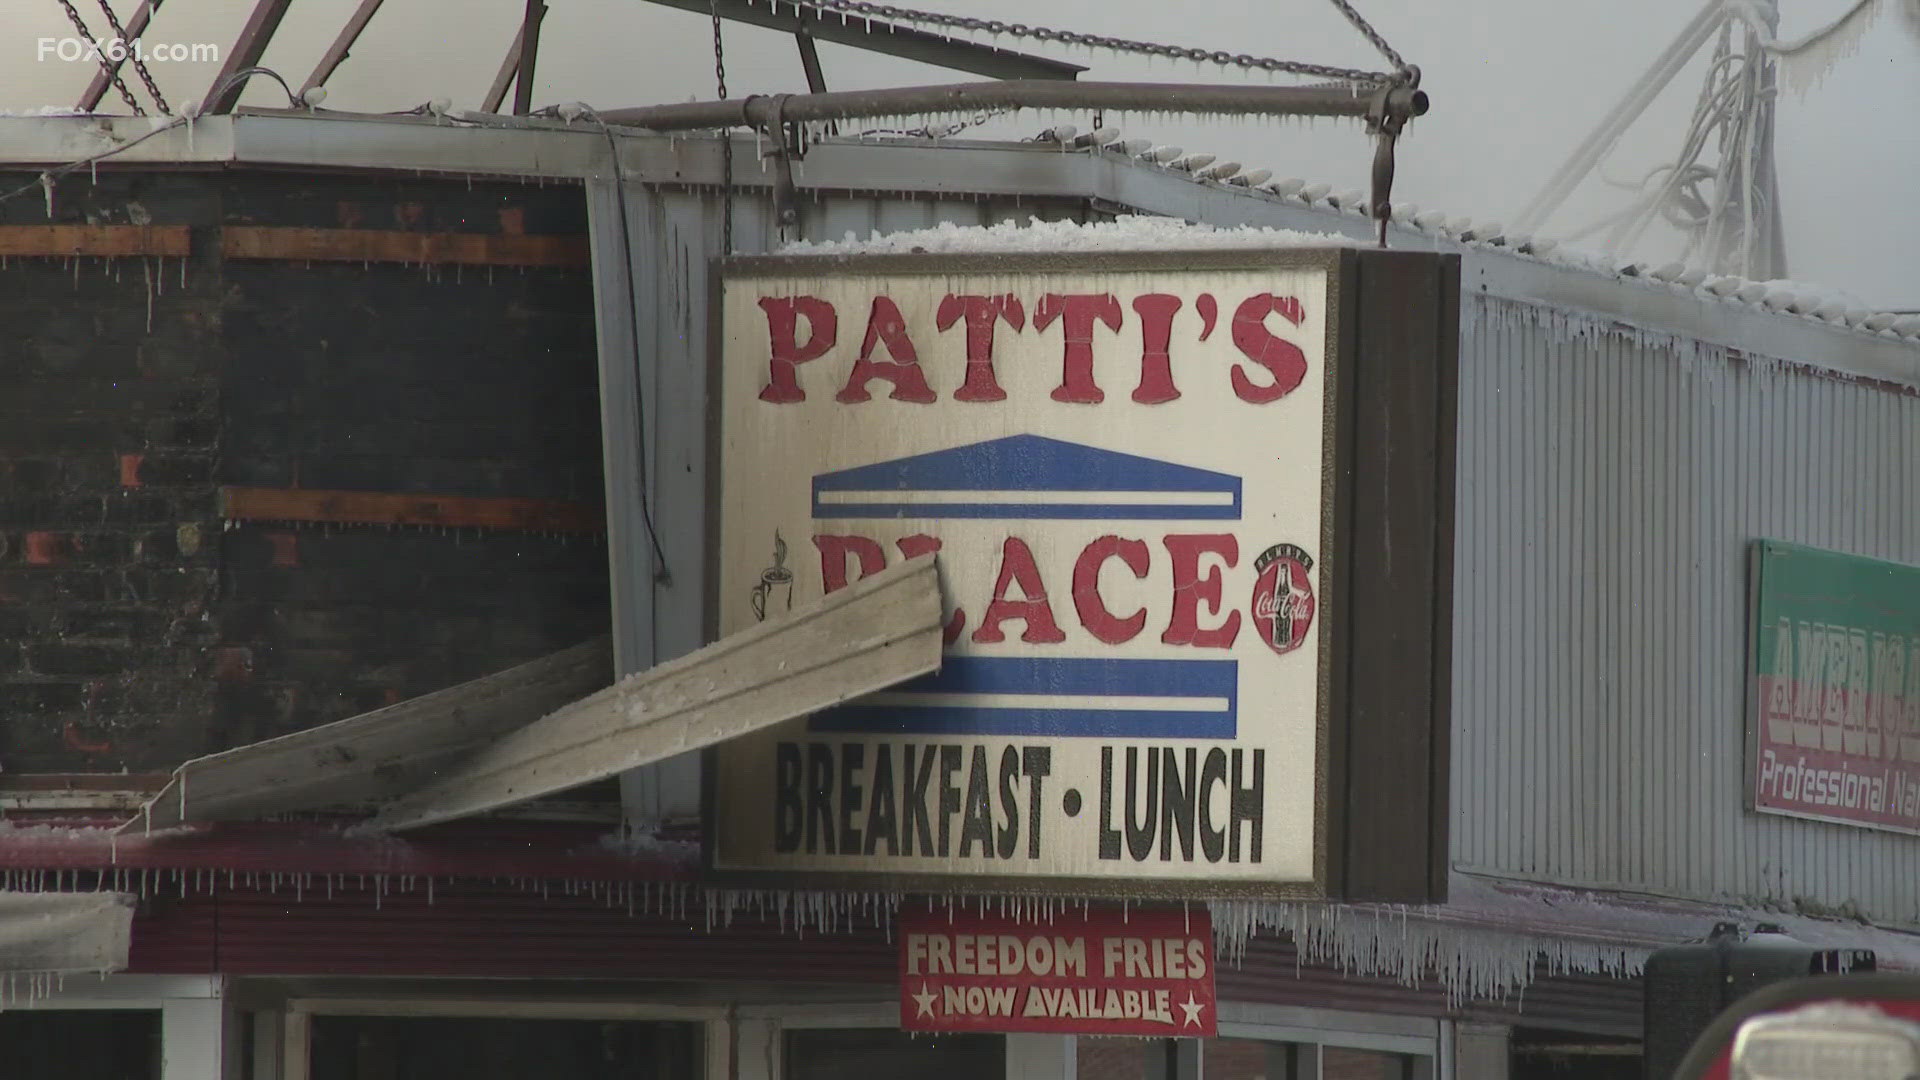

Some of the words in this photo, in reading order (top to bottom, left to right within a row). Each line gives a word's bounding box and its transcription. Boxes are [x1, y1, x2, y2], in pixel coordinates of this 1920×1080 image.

[758, 293, 1308, 404] PATTI'S
[811, 533, 1241, 648] PACE
[775, 742, 1051, 861] BREAKFAST
[1098, 746, 1265, 863] LUNCH
[1760, 749, 1889, 813] Professional
[906, 934, 1087, 977] FREEDOM
[1103, 937, 1207, 980] FRIES
[943, 985, 1019, 1017] NOW
[1021, 986, 1176, 1025] AVAILABLE
